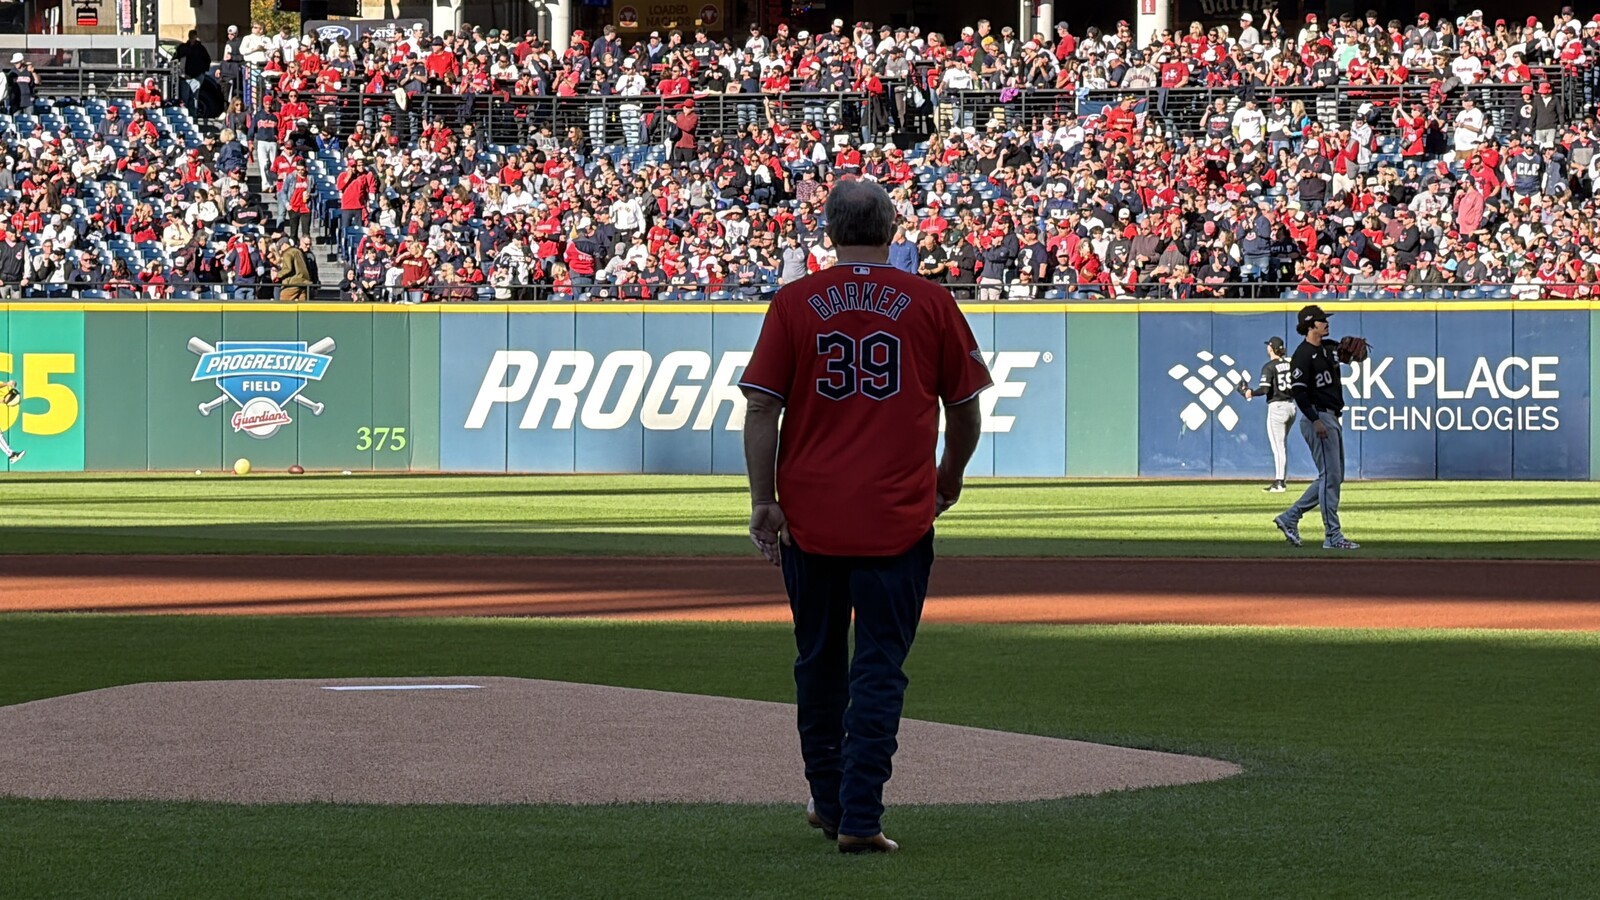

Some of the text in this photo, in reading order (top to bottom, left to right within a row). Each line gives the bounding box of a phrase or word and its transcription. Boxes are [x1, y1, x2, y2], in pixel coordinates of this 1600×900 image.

[649, 5, 688, 15] LOADED
[1517, 162, 1539, 175] CLE
[808, 282, 911, 321] BARKER
[205, 353, 319, 374] PROGRESSIVE
[816, 331, 901, 401] 39
[242, 381, 281, 392] FIELD
[1315, 370, 1333, 388] 20
[1406, 357, 1560, 399] PLACE
[232, 411, 291, 430] Guardians
[355, 426, 407, 451] 375
